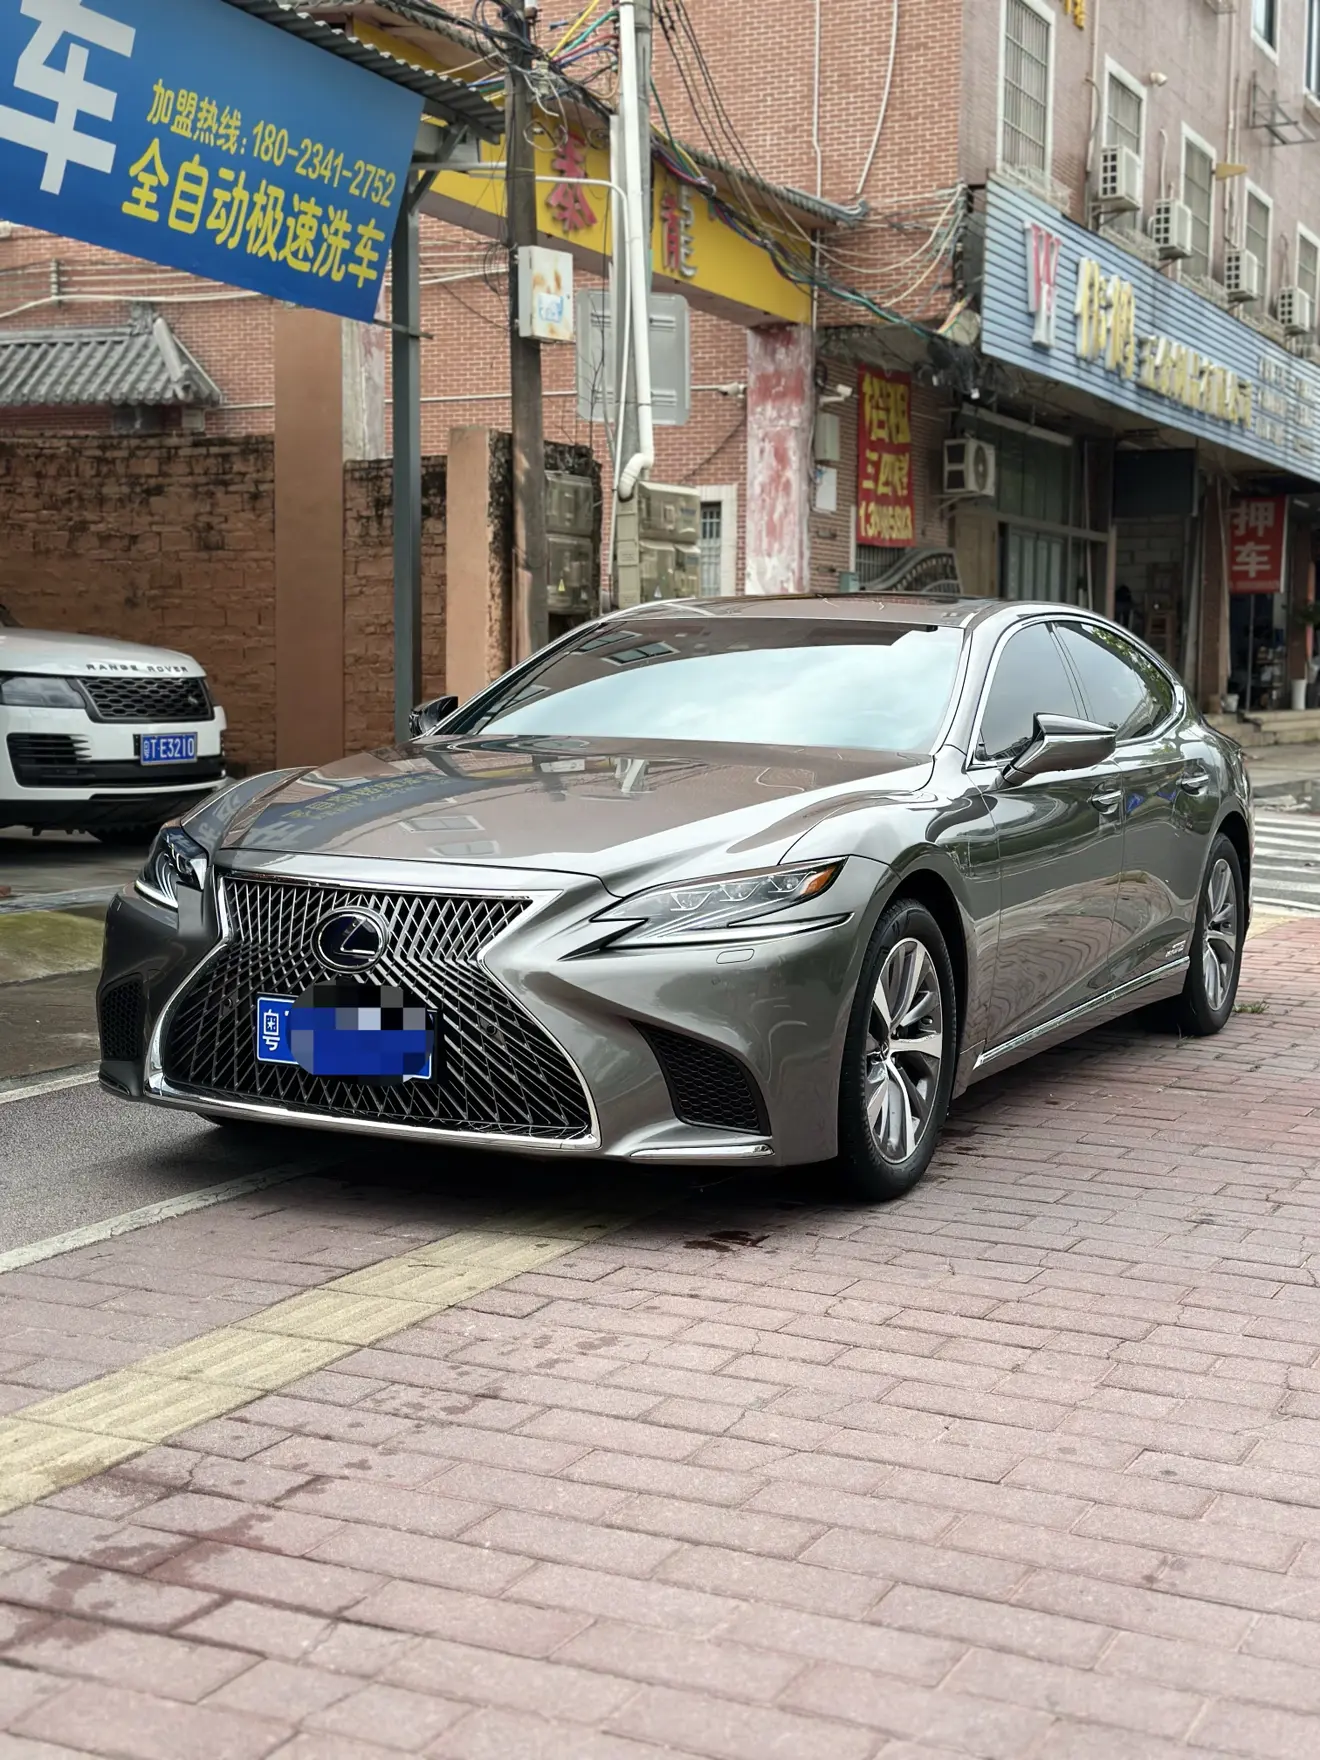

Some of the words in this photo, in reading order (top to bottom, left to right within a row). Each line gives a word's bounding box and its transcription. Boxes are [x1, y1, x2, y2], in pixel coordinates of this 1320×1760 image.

[0, 0, 136, 196] 车
[121, 137, 386, 288] 全自动极速洗车
[86, 664, 139, 672] RANGE
[146, 665, 189, 673] ROVER
